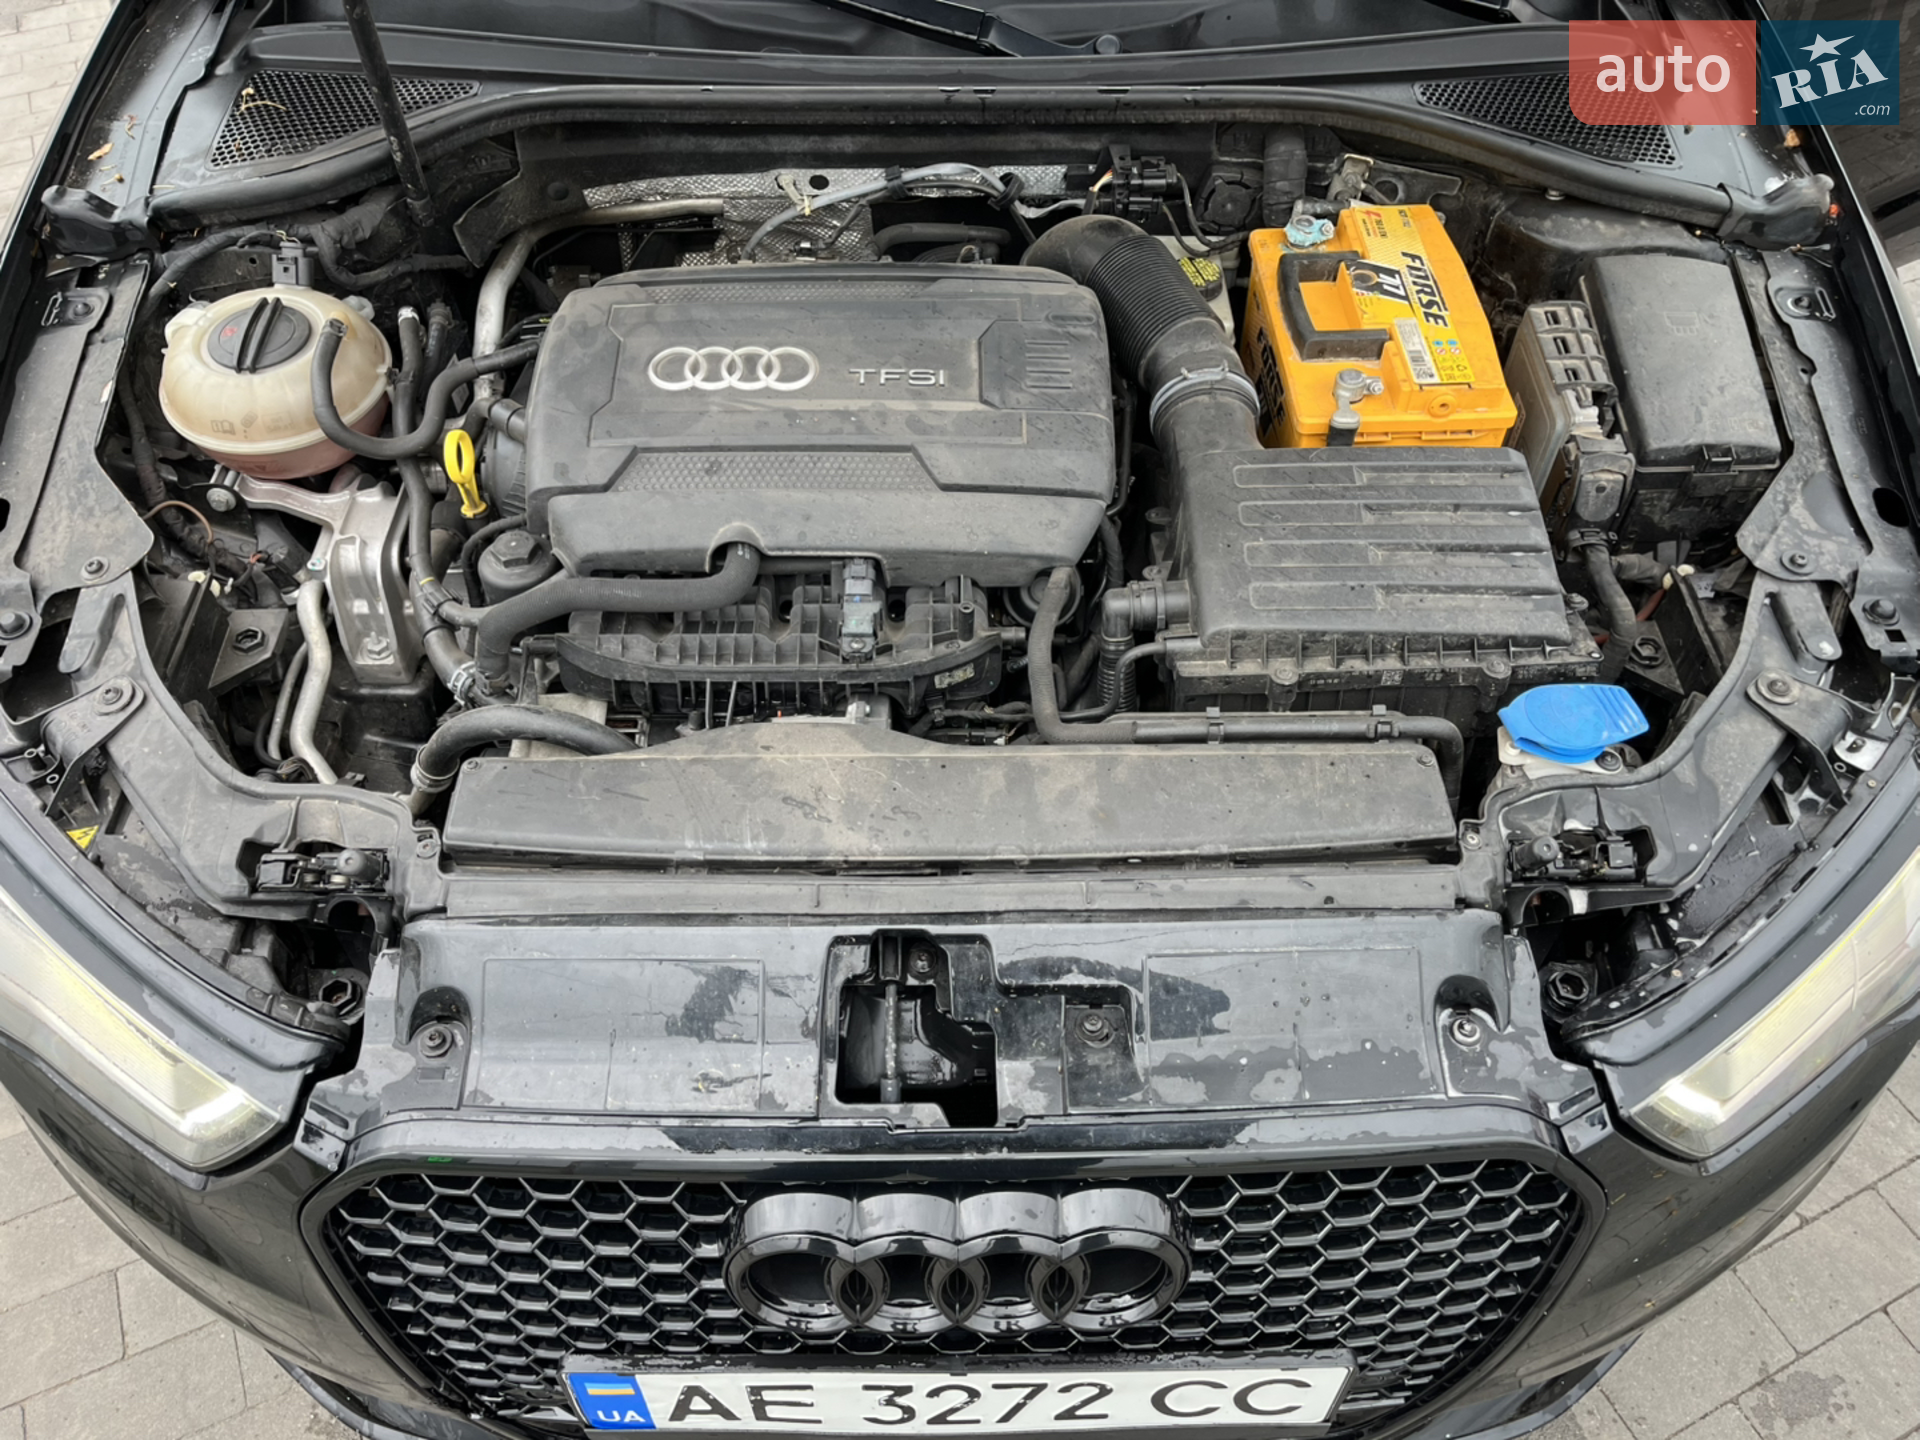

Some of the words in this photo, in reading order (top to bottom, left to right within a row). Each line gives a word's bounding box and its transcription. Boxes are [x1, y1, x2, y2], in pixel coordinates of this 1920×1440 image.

[848, 368, 945, 387] TFSI
[668, 1384, 823, 1425] AE
[861, 1382, 1115, 1426] 3272
[1150, 1378, 1314, 1418] CC
[596, 1409, 647, 1423] UA
